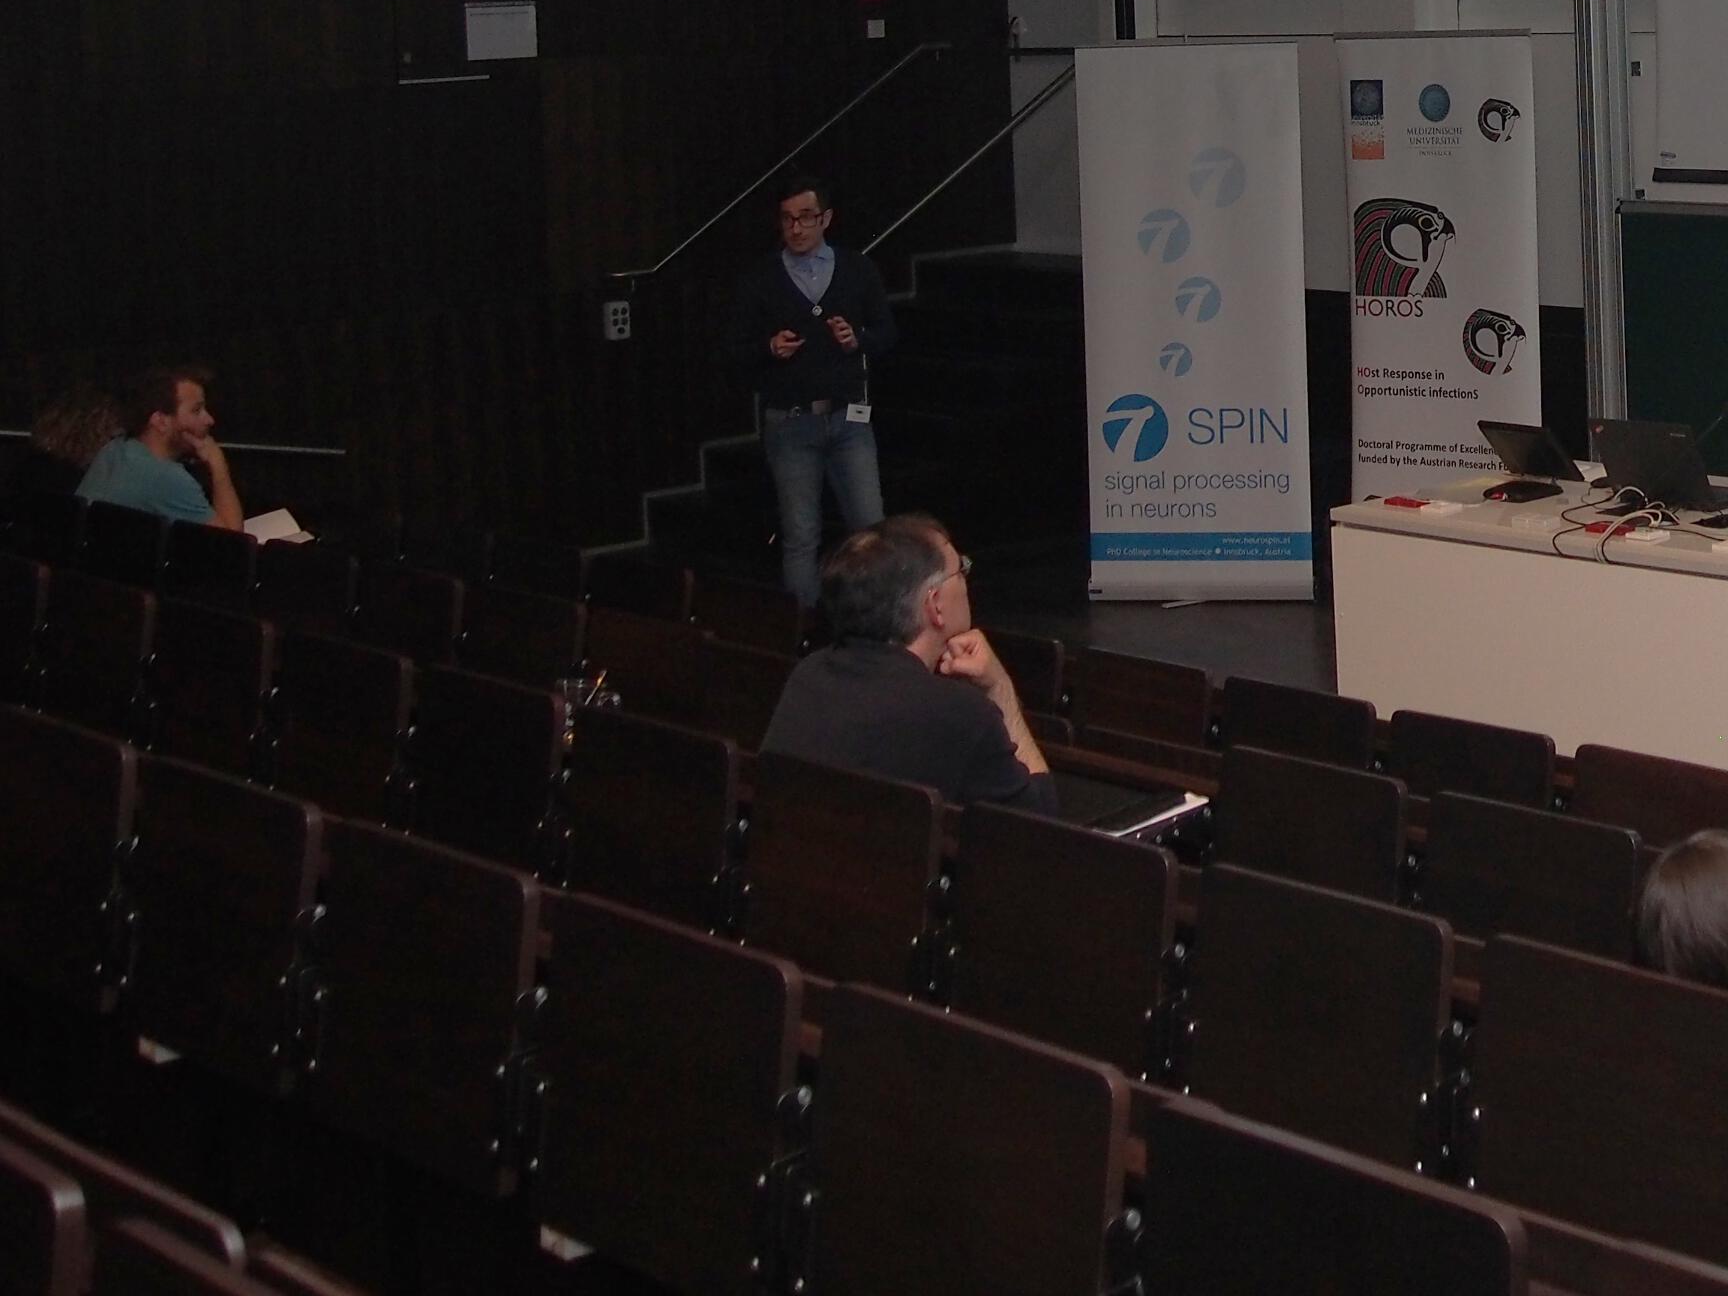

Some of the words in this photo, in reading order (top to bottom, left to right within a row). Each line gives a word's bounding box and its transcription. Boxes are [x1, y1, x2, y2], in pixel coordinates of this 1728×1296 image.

[1355, 298, 1424, 317] HOROS
[1357, 367, 1380, 379] HOst
[1383, 368, 1432, 382] Response
[1435, 369, 1445, 380] in
[1357, 384, 1427, 398] Opportunistic
[1429, 386, 1479, 400] infectionS
[1188, 407, 1289, 445] SPIN
[1358, 439, 1394, 450] Doctoral
[1395, 441, 1447, 455] Programme
[1449, 442, 1458, 453] of
[1358, 454, 1389, 465] funded
[1390, 454, 1401, 467] by
[1402, 455, 1418, 466] the
[1419, 457, 1457, 468] Austrian
[1458, 460, 1497, 471] Research
[1104, 470, 1165, 494] signal
[1173, 470, 1290, 494] processing
[1106, 499, 1122, 518] in
[1131, 501, 1217, 518] neurons
